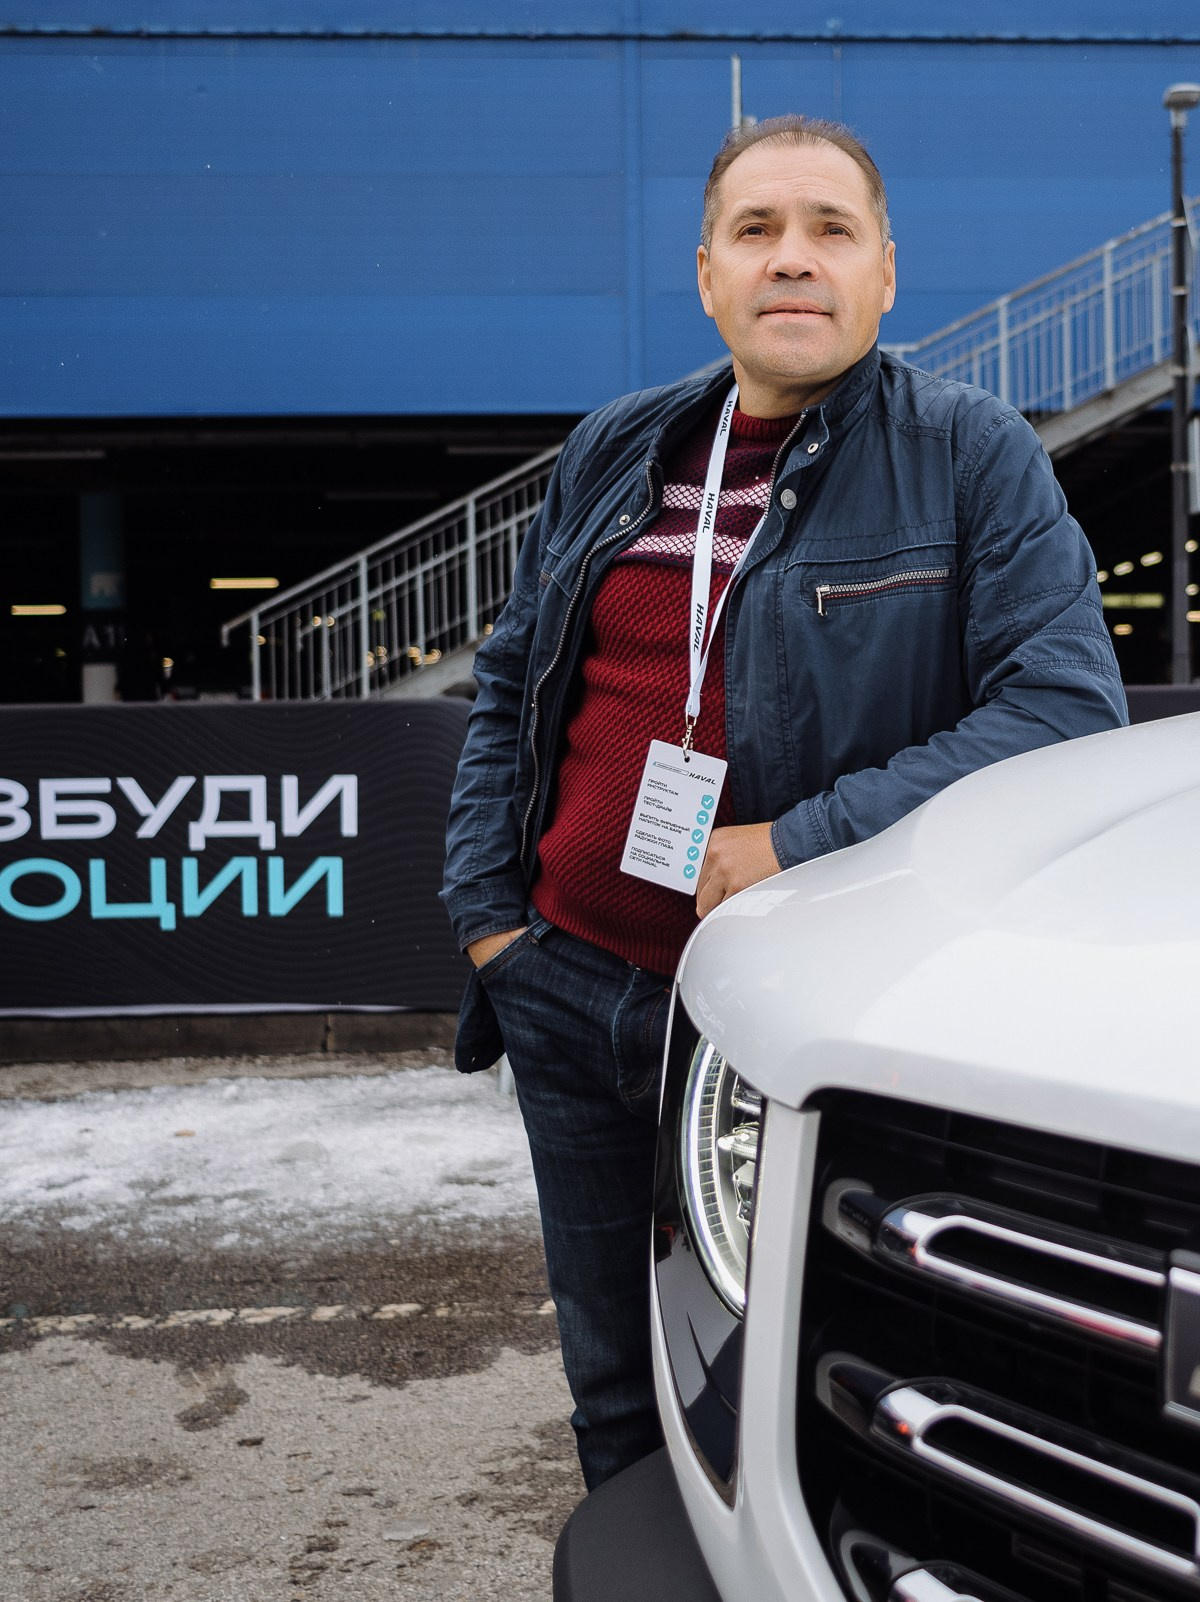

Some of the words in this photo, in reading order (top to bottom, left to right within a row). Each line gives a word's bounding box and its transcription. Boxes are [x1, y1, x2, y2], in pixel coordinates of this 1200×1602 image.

[719, 399, 734, 437] HAVAL
[702, 492, 716, 534] HAVAL
[693, 603, 705, 653] HAVAL
[648, 779, 667, 788] ПРОЙТИ
[688, 772, 717, 785] HAVAL
[644, 796, 663, 805] ПРОЙТИ
